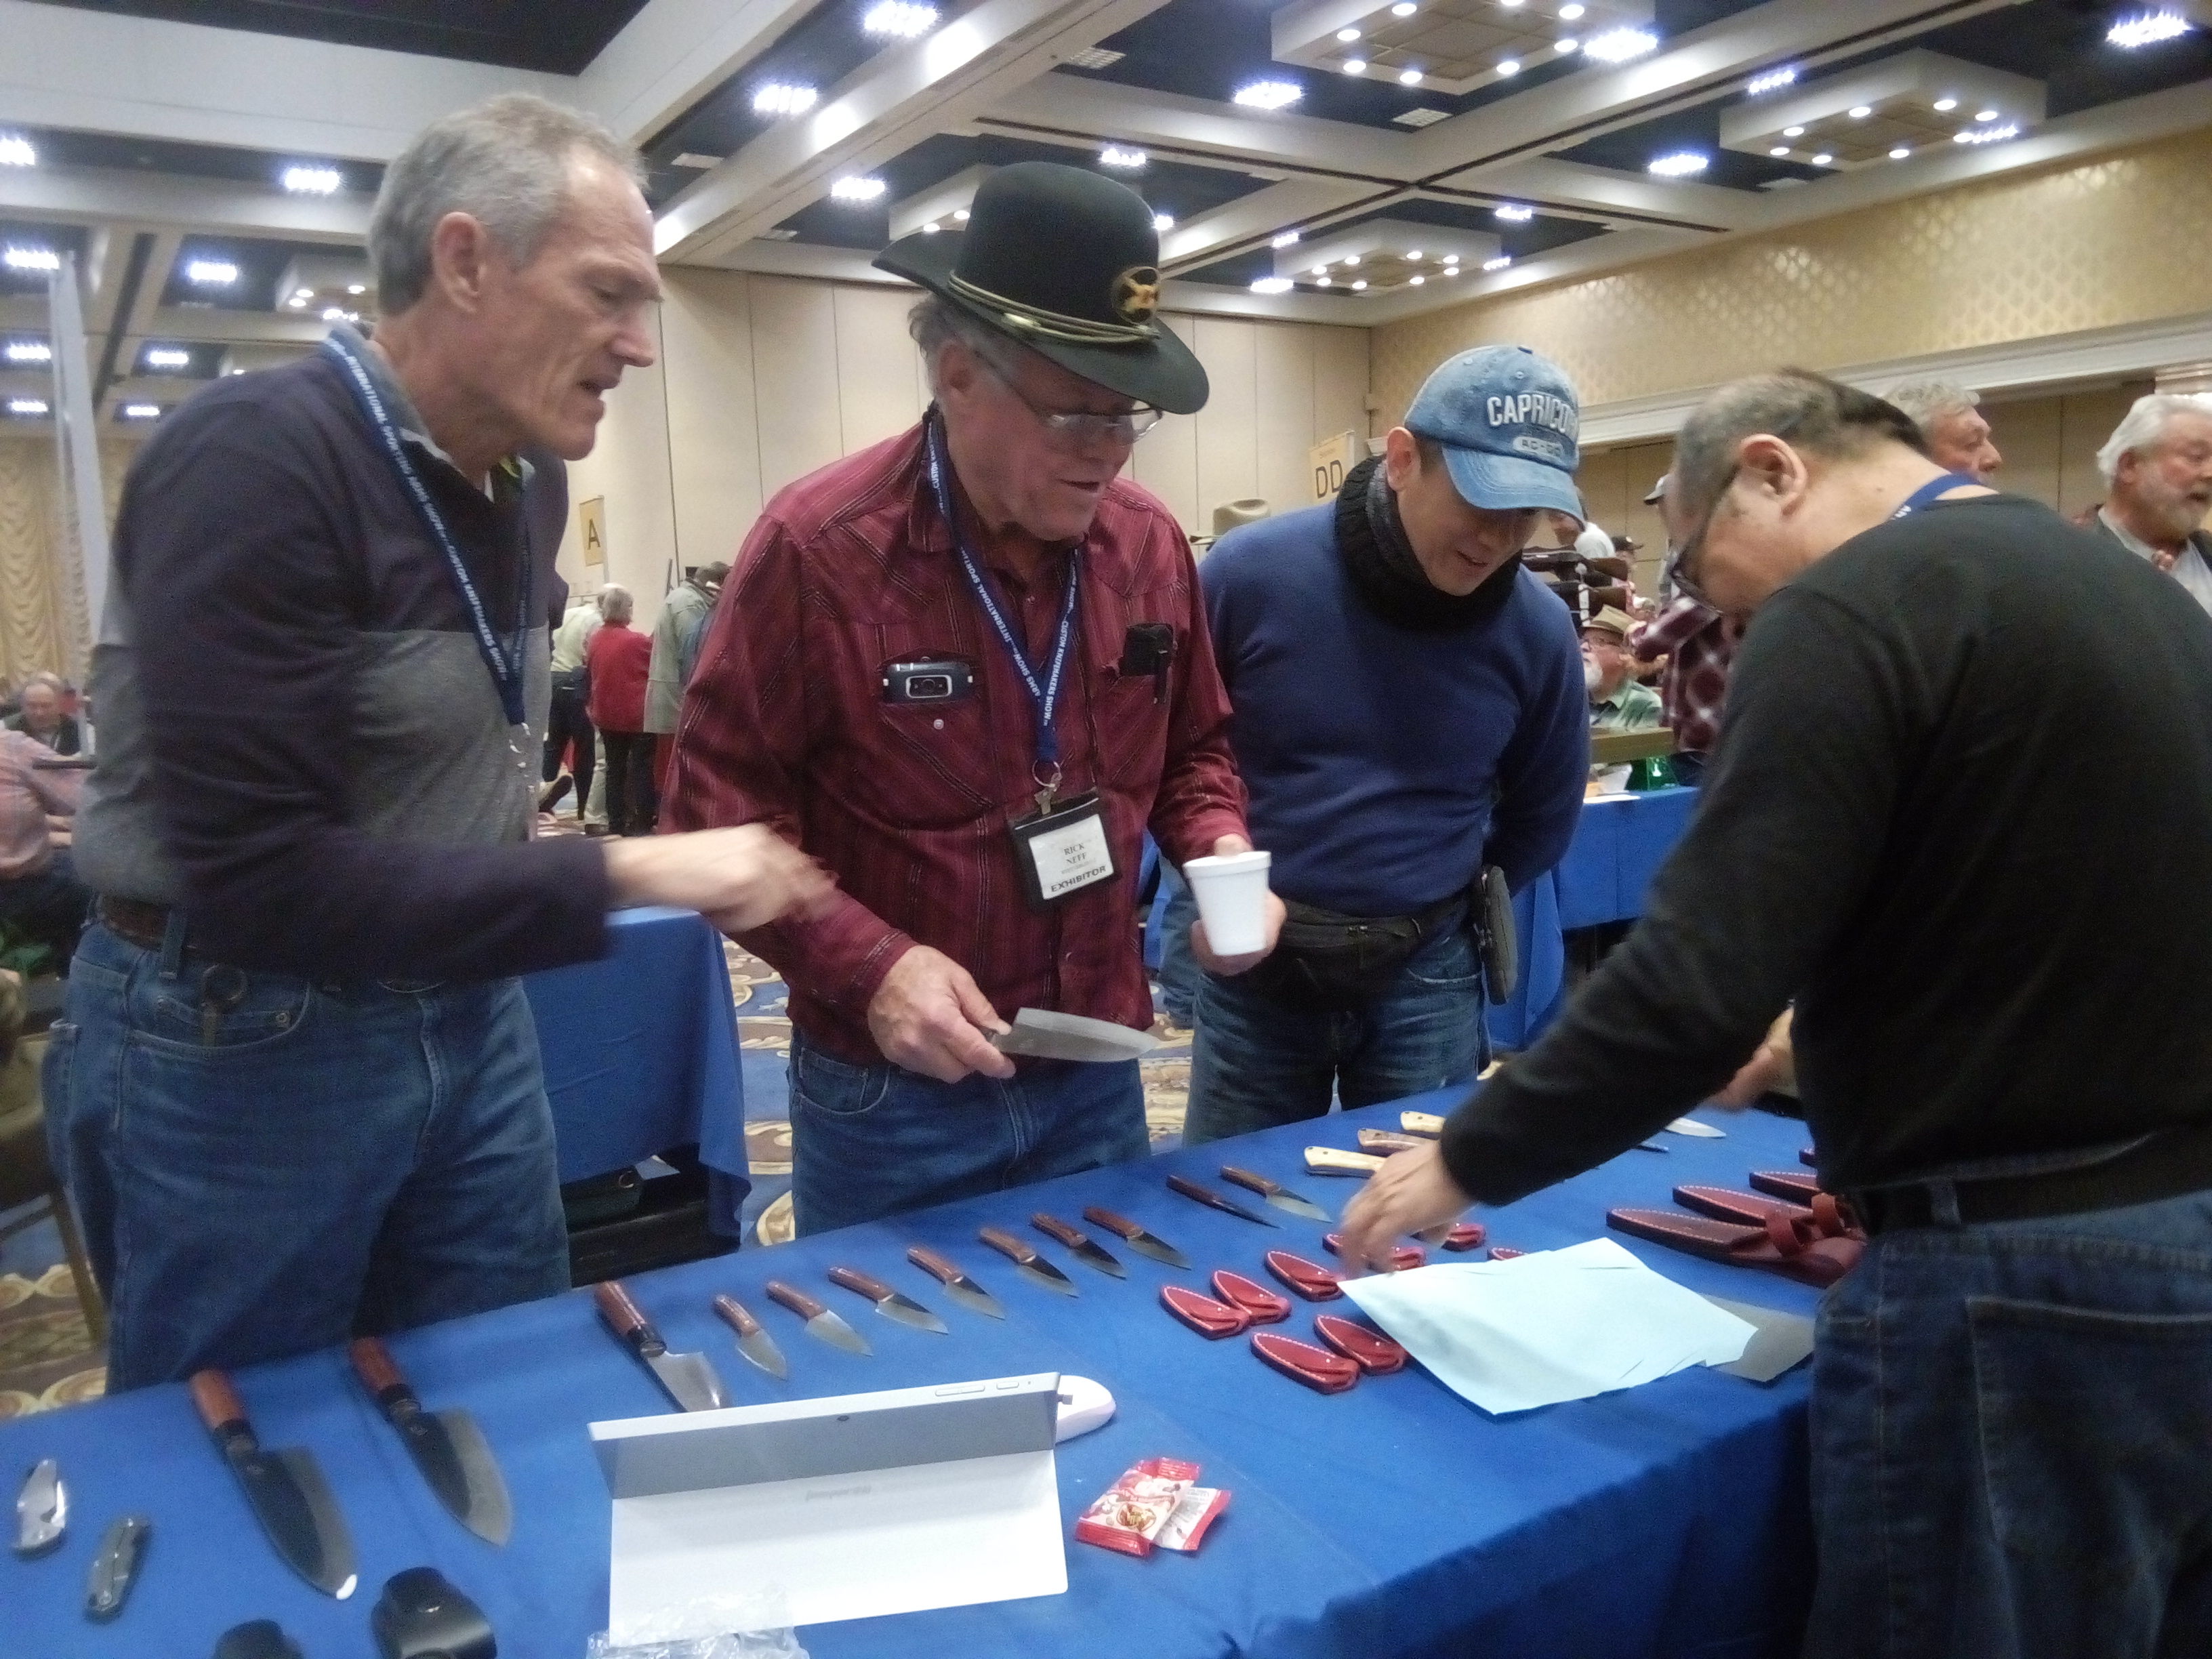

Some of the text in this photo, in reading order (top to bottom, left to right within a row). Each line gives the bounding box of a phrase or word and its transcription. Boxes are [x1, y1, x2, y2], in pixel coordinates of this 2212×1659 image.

[1487, 394, 1575, 434] CAPRICO
[1315, 459, 1343, 498] DD
[588, 518, 600, 550] A
[977, 583, 1012, 643] INTERNATIONAL
[1059, 620, 1069, 648] CUSTOM
[1048, 647, 1065, 695] KNIFEMAKERS
[1027, 678, 1041, 697] ARMS
[1064, 843, 1084, 855] RICK
[1066, 853, 1086, 863] NEFF
[1051, 865, 1105, 892] EXHIBITOR
